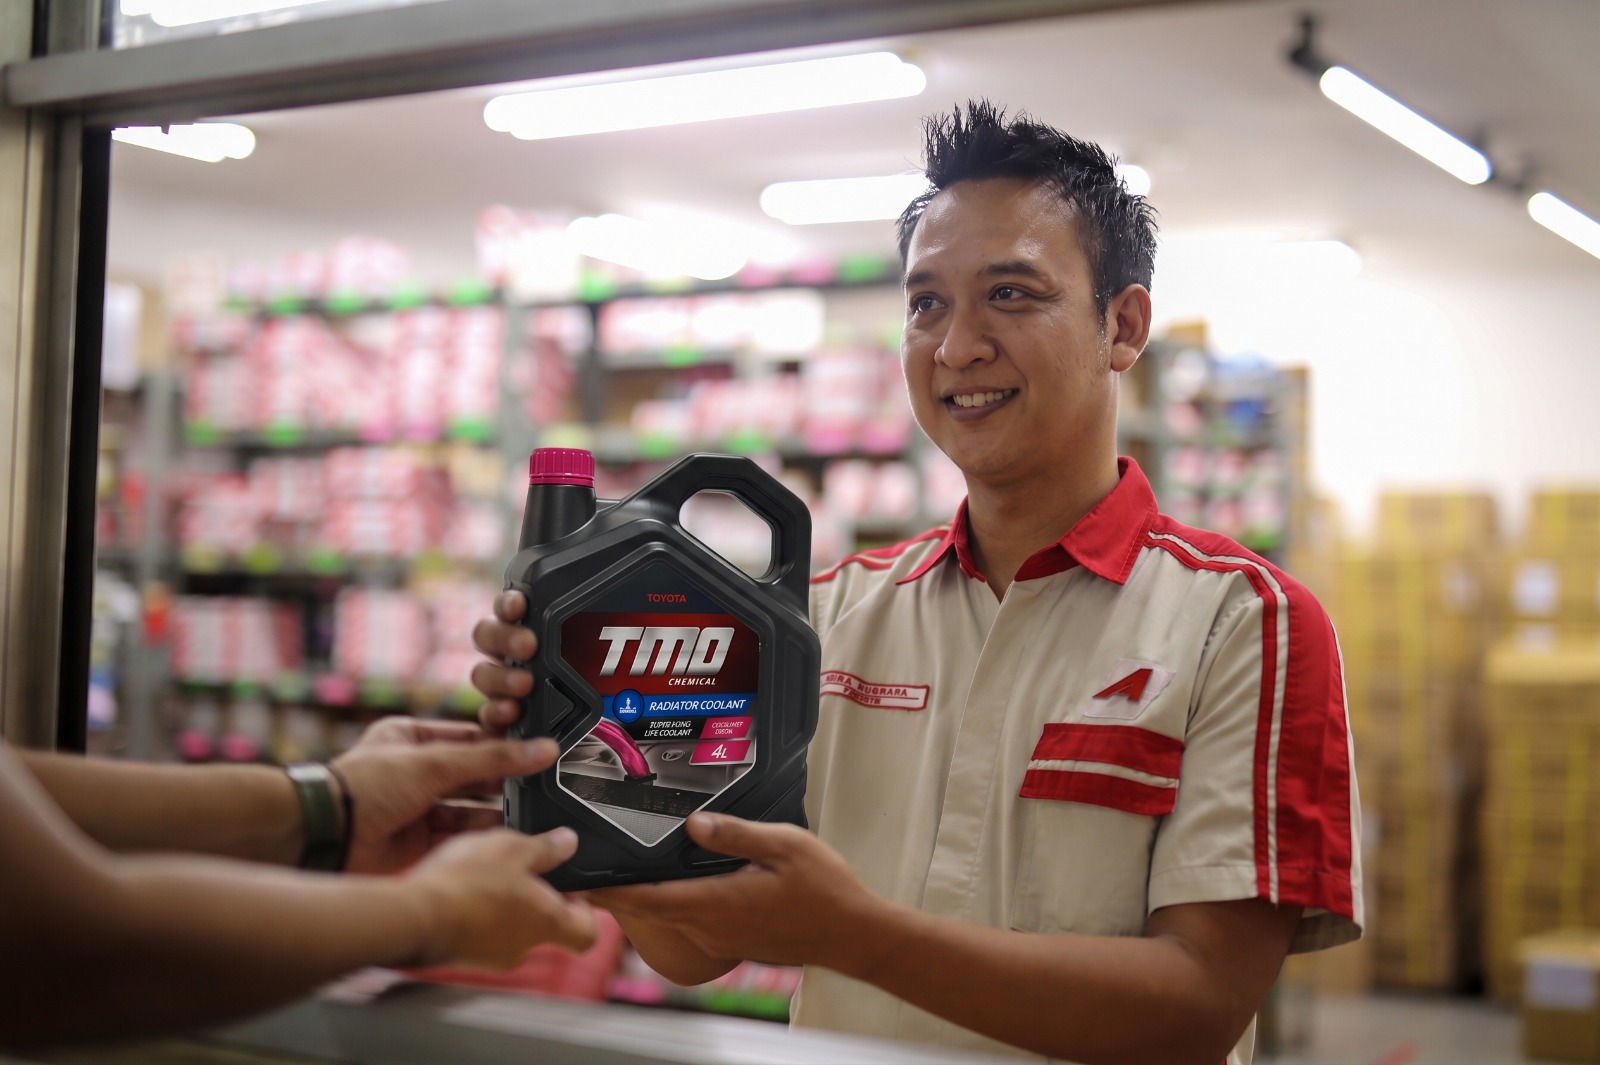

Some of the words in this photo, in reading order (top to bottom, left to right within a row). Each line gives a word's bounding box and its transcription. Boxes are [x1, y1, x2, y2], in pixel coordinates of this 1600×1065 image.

[647, 594, 687, 603] TOYOTA
[599, 626, 735, 676] TMO
[668, 678, 716, 686] CHEMICAL
[649, 701, 699, 711] RADIATOR
[700, 699, 746, 710] COOLANT
[711, 743, 727, 759] 4L
